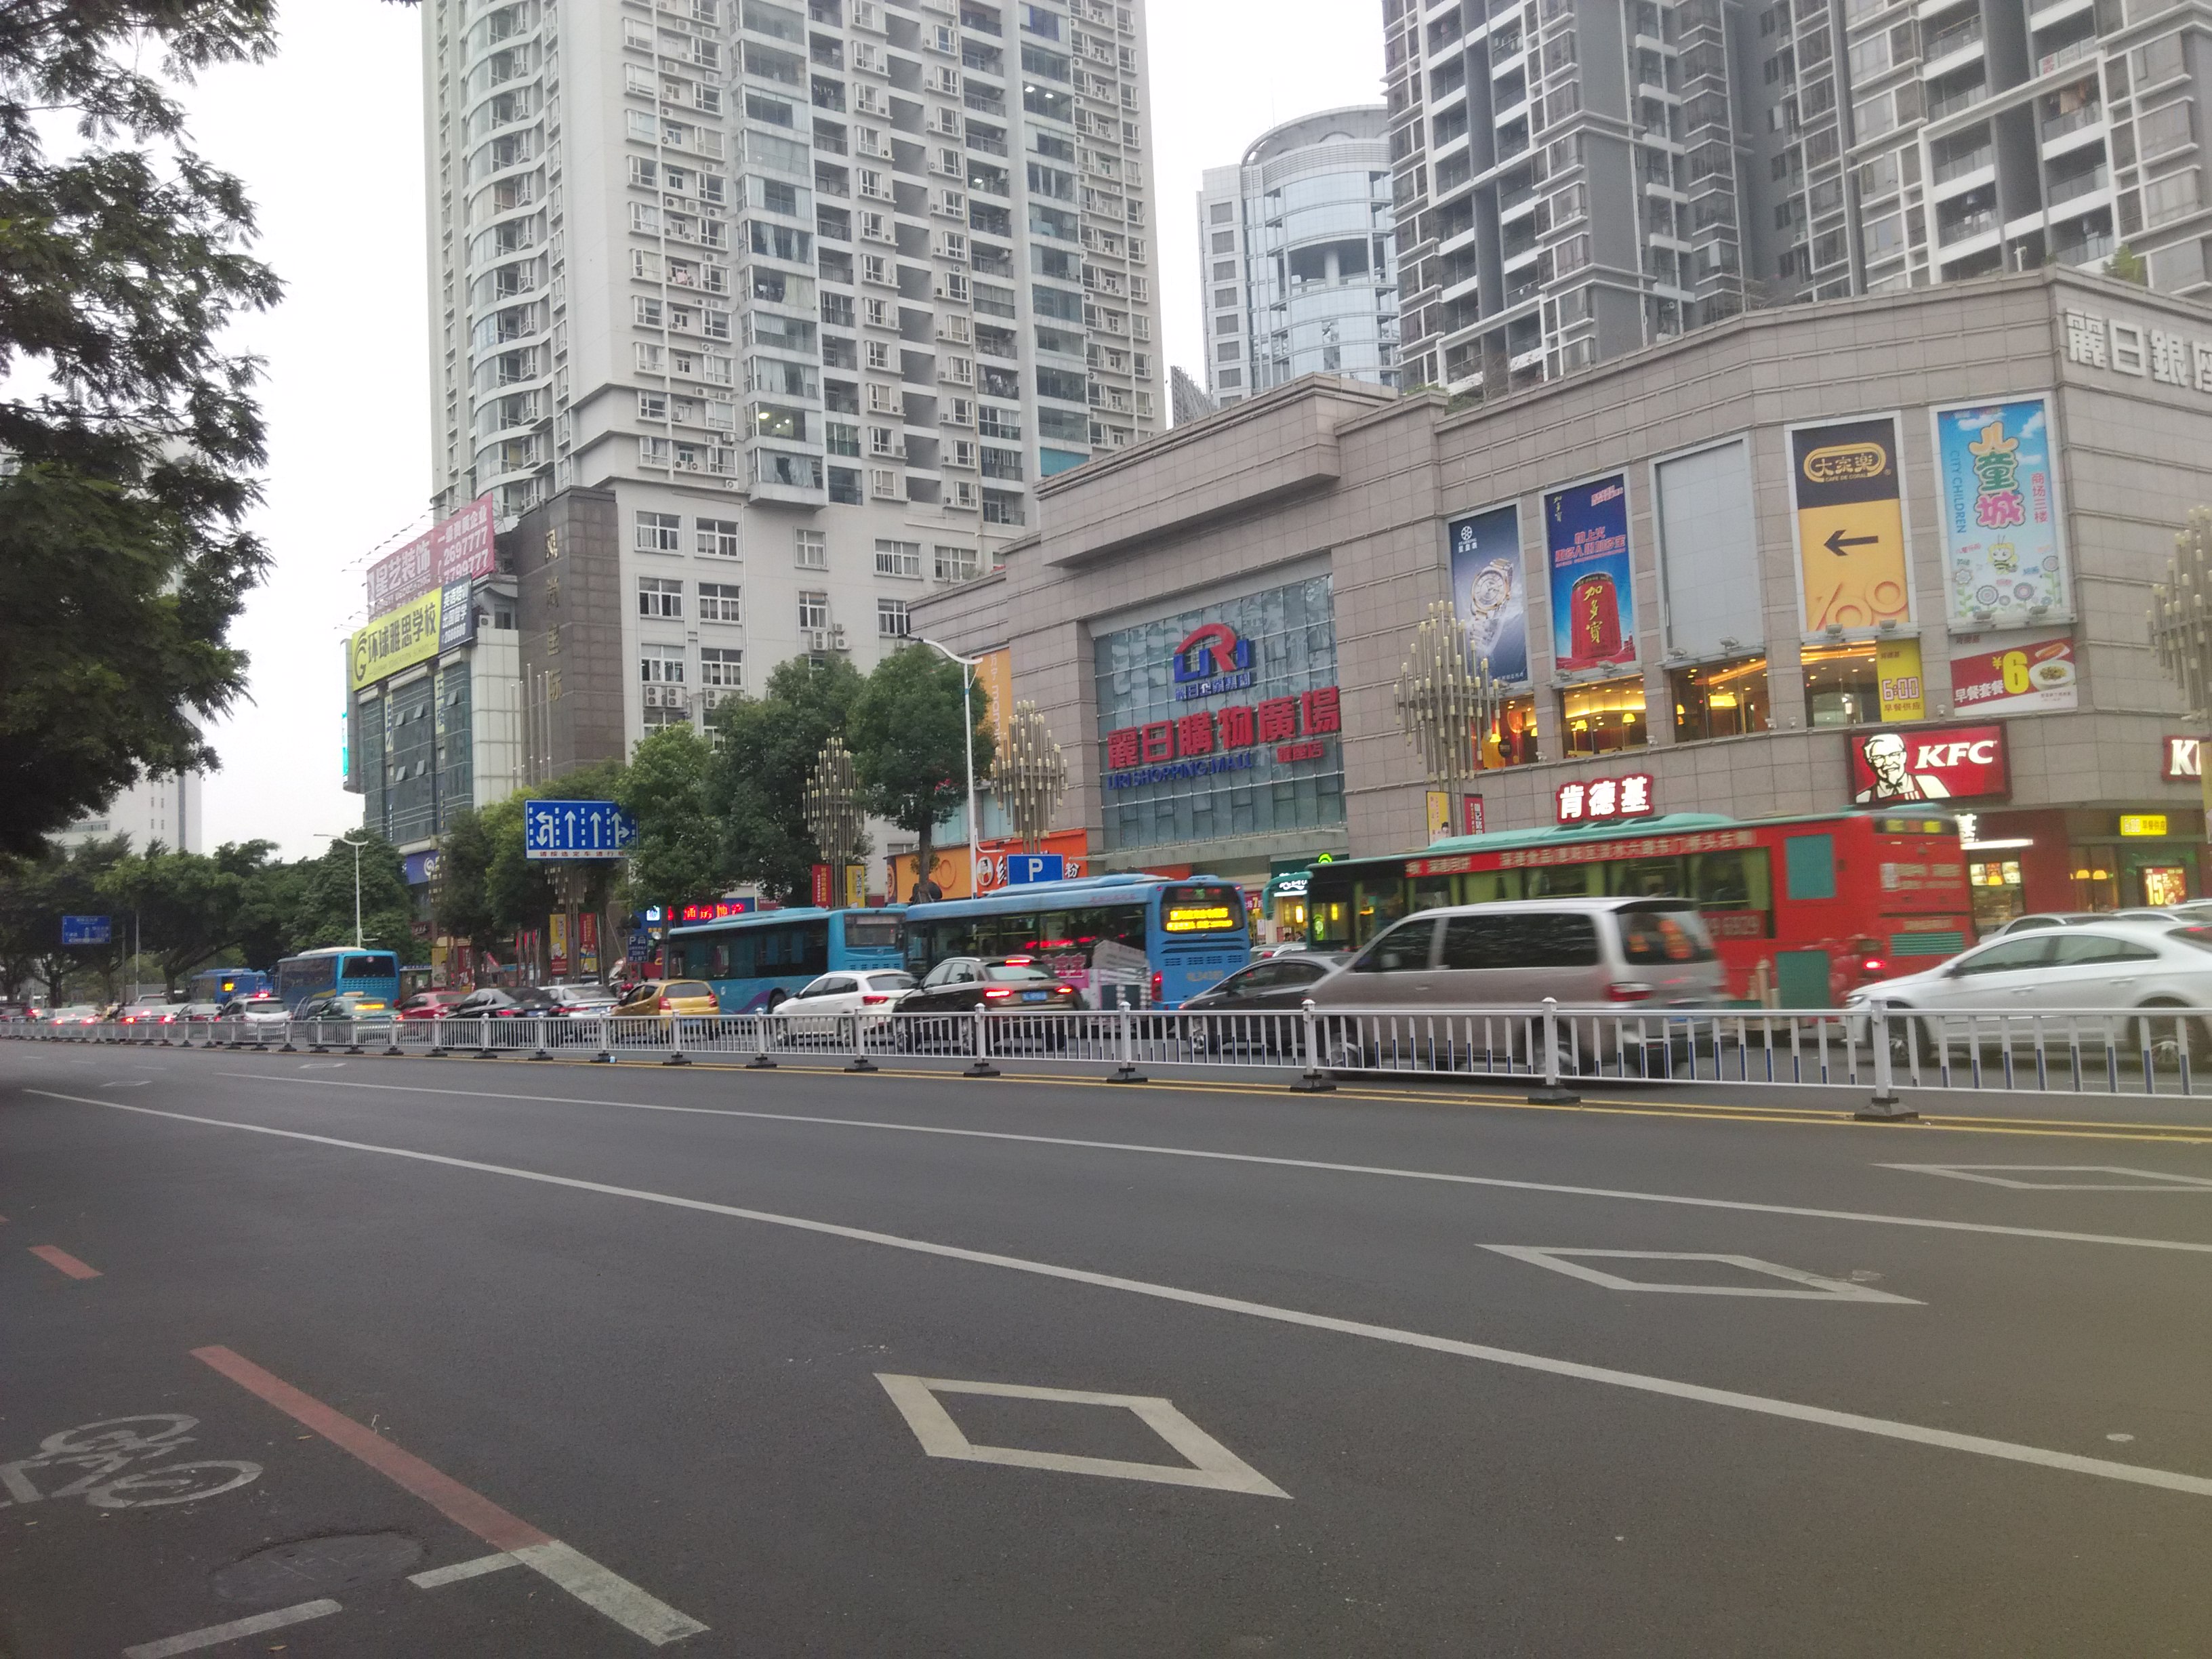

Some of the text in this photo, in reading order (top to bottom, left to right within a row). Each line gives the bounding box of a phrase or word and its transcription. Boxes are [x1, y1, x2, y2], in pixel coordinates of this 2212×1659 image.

[1950, 450, 1967, 533] CITY CHILDREN
[1969, 421, 2025, 529] 儿童城
[2031, 472, 2048, 523] 商场三楼
[443, 526, 488, 566] 2697777
[375, 540, 431, 594] 星艺装饰
[367, 602, 436, 665] 环球雅思学校
[1882, 677, 1921, 701] 6:00
[1884, 702, 1921, 712] 早餐供应
[1954, 679, 2005, 703] 早餐套餐
[1107, 686, 1341, 770] 麗日購物廣場
[1133, 760, 1208, 786] SHOPPING
[1211, 752, 1253, 775] MALL
[1914, 740, 1994, 769] KFC
[1559, 776, 1650, 819] 肯德基
[1029, 858, 1043, 882] P
